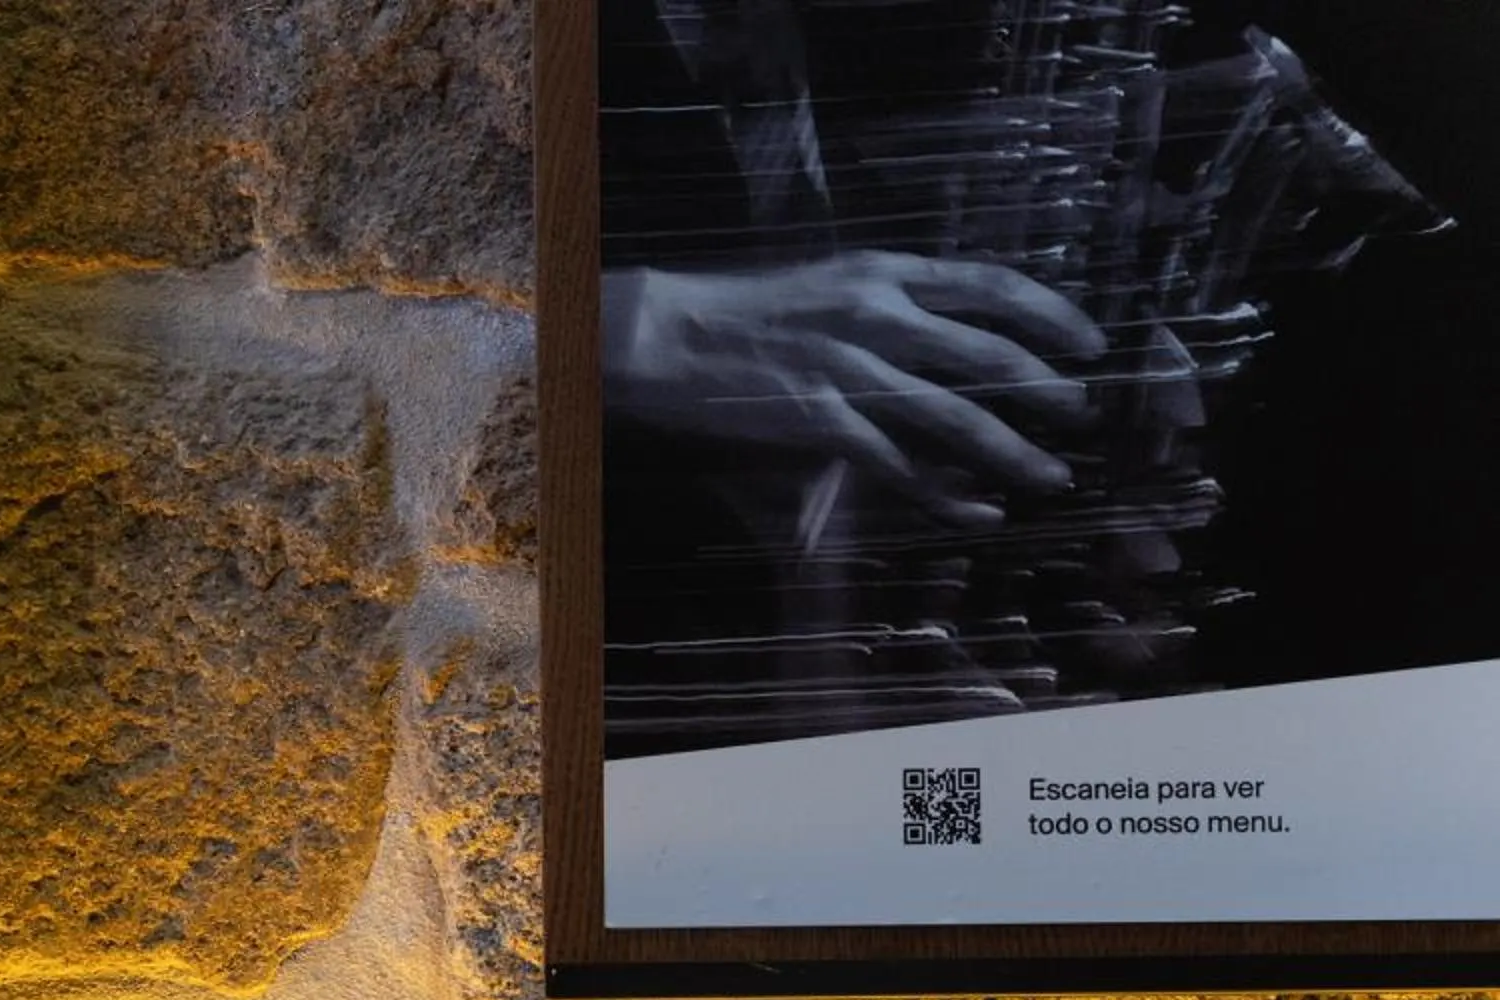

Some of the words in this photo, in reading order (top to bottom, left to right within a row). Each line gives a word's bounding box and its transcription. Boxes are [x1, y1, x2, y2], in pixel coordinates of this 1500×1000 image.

[1028, 777, 1150, 801] Escaneia
[1157, 781, 1216, 805] para
[1223, 779, 1265, 799] ver
[1028, 812, 1090, 835] todo
[1095, 816, 1113, 835] o
[1119, 816, 1201, 835] nosso
[1207, 814, 1290, 833] menu.
